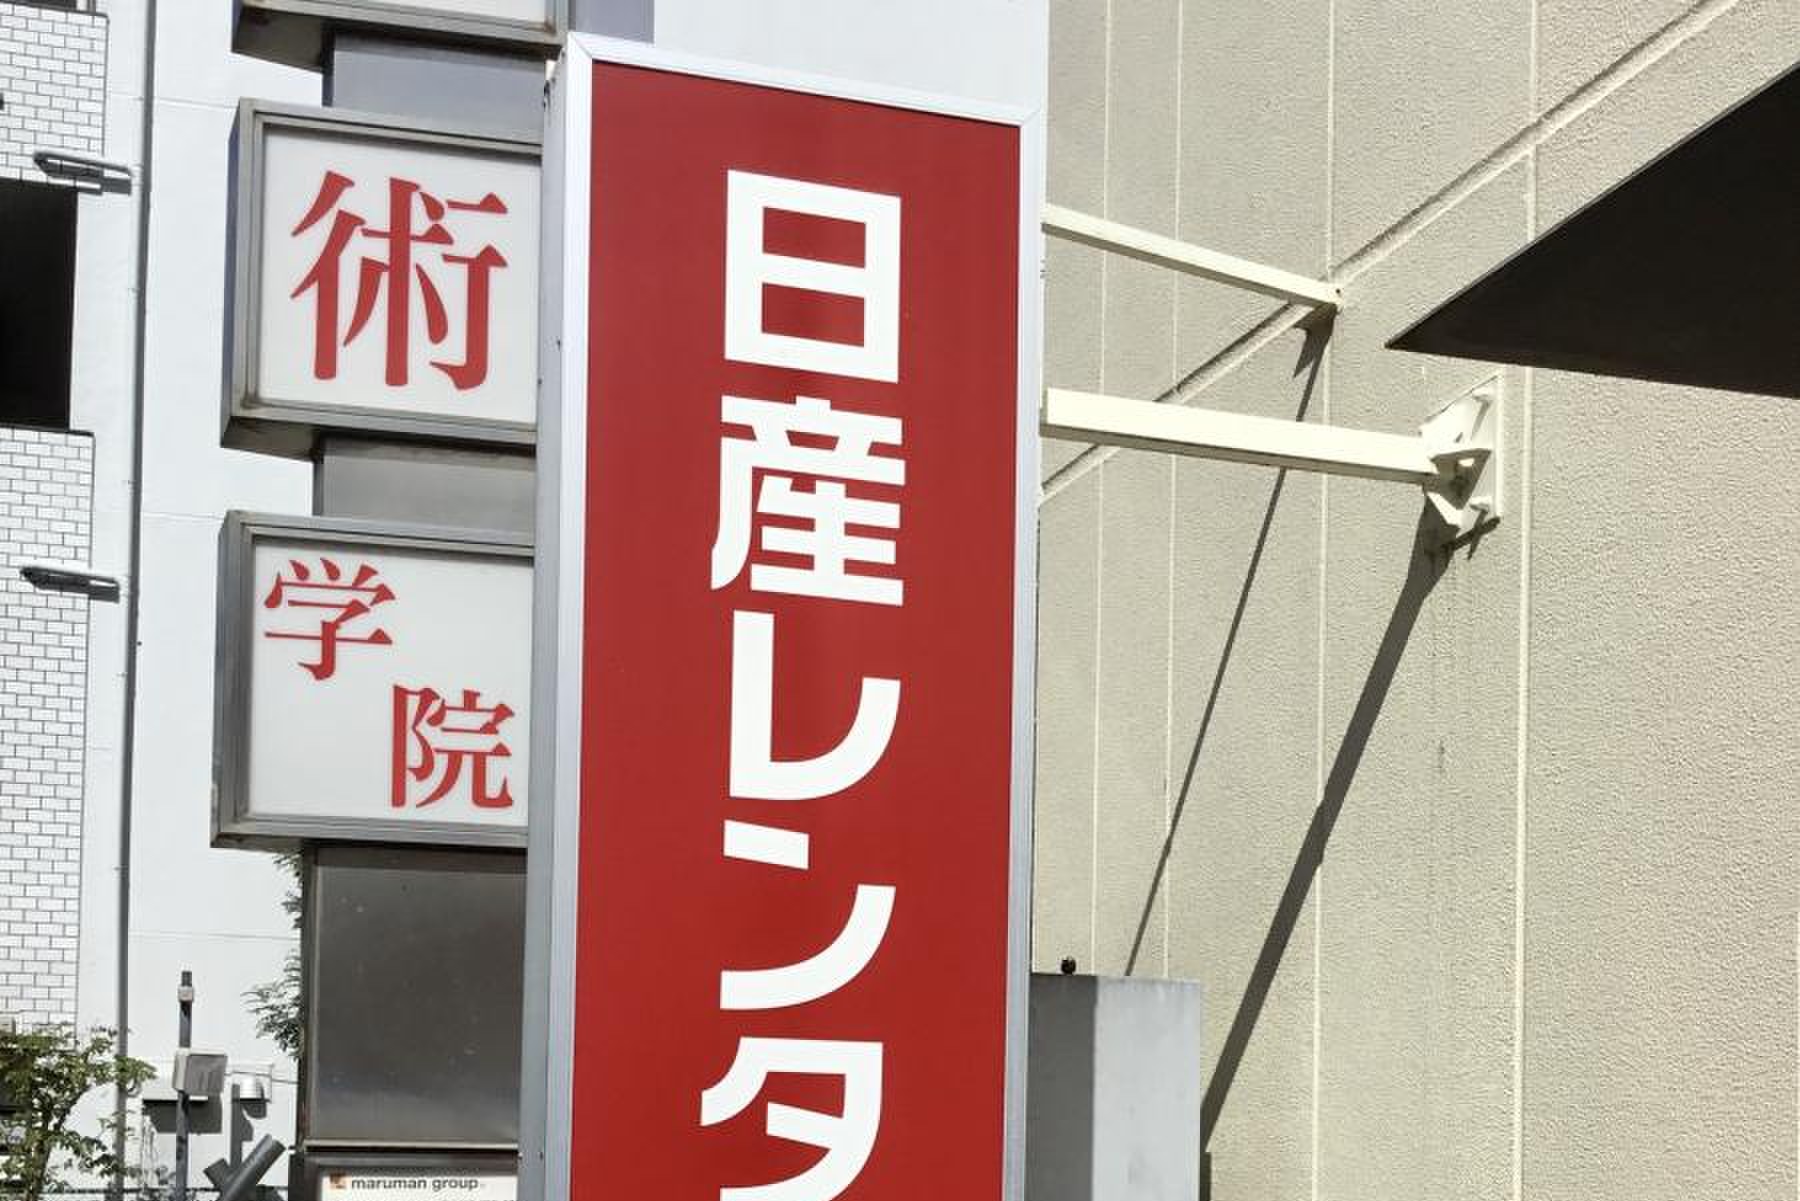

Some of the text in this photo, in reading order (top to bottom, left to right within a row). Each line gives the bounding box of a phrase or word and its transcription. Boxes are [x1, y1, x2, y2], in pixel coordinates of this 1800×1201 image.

[290, 170, 508, 391] 術
[263, 556, 514, 810] 学院
[351, 1178, 479, 1192] maruman group
